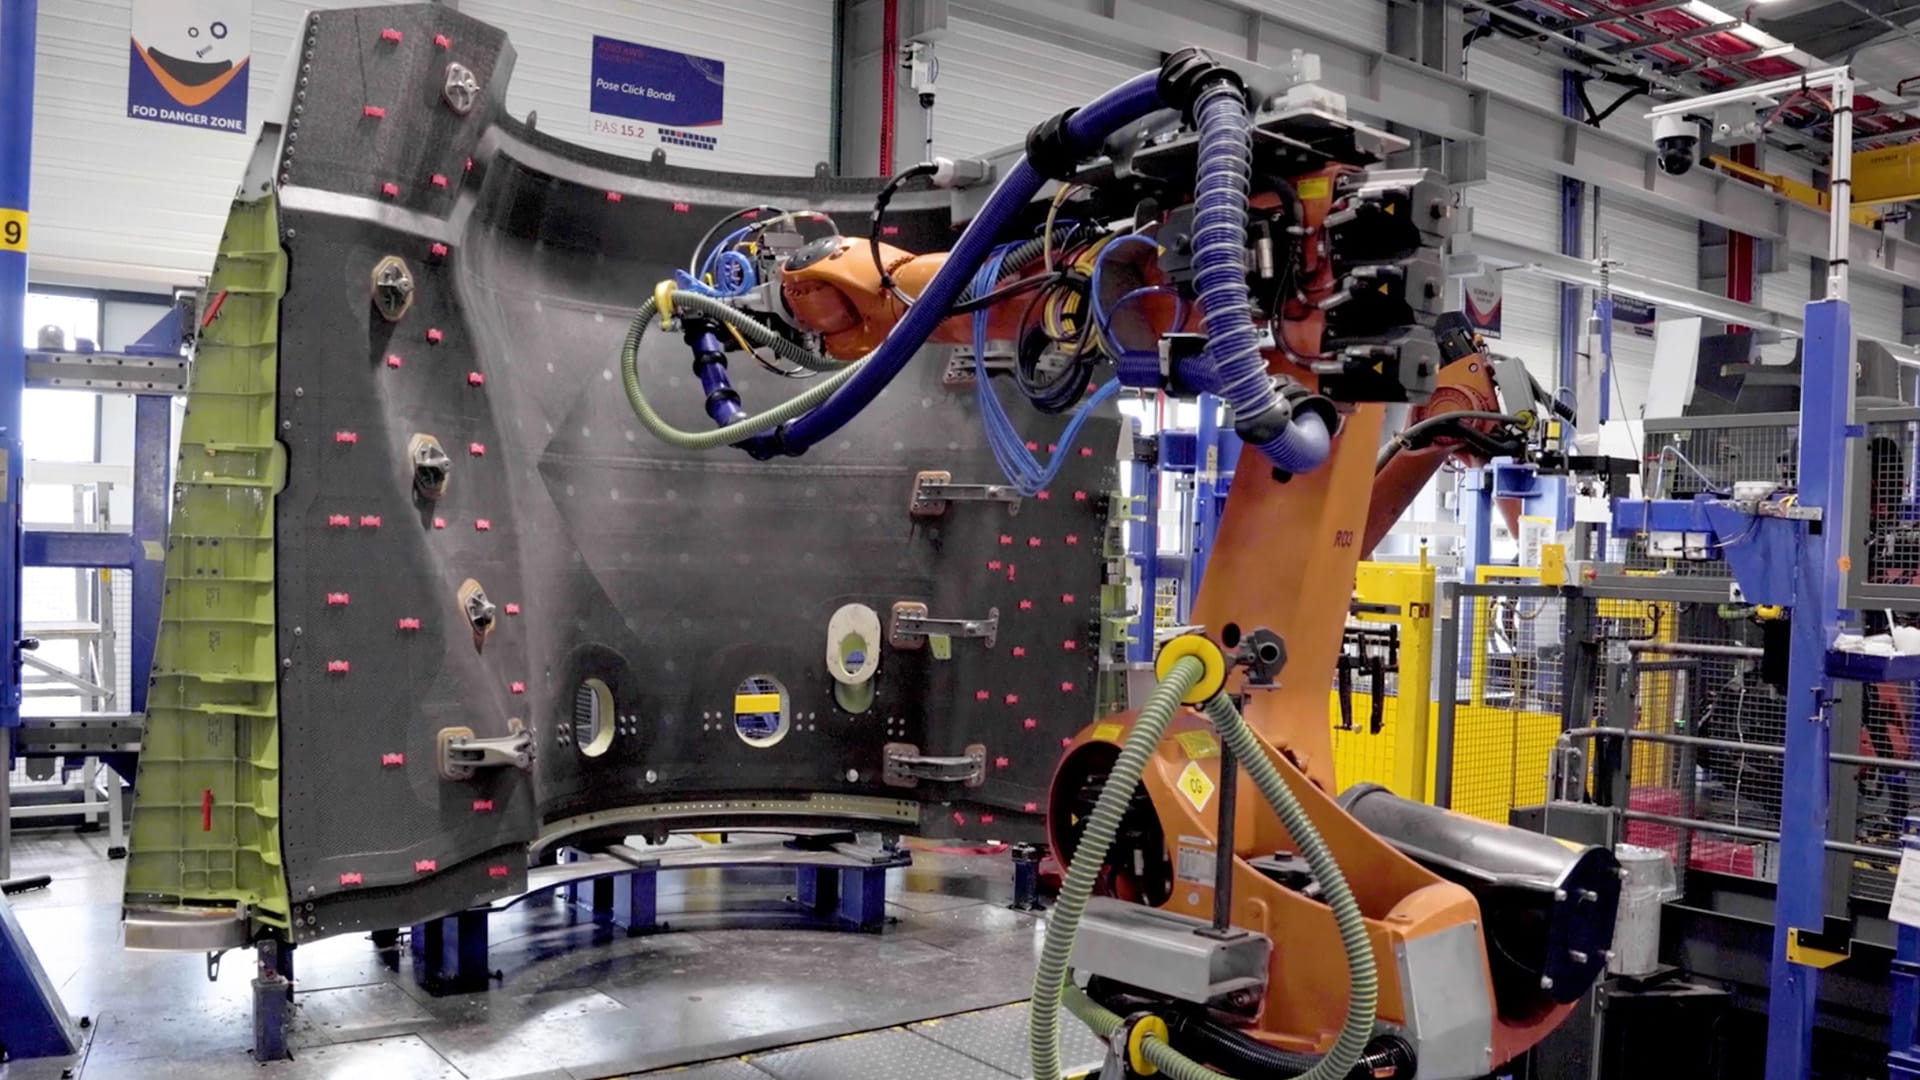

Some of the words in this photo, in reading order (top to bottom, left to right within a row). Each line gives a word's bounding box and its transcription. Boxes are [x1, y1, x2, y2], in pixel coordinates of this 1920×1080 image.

[596, 78, 619, 91] Pose
[621, 83, 645, 97] Click
[646, 88, 676, 102] Bonds
[132, 105, 158, 117] FOD
[160, 108, 208, 125] DANGER
[210, 116, 243, 130] ZONE
[594, 120, 618, 134] PAS
[621, 124, 645, 138] 15.2
[4, 220, 22, 245] 9
